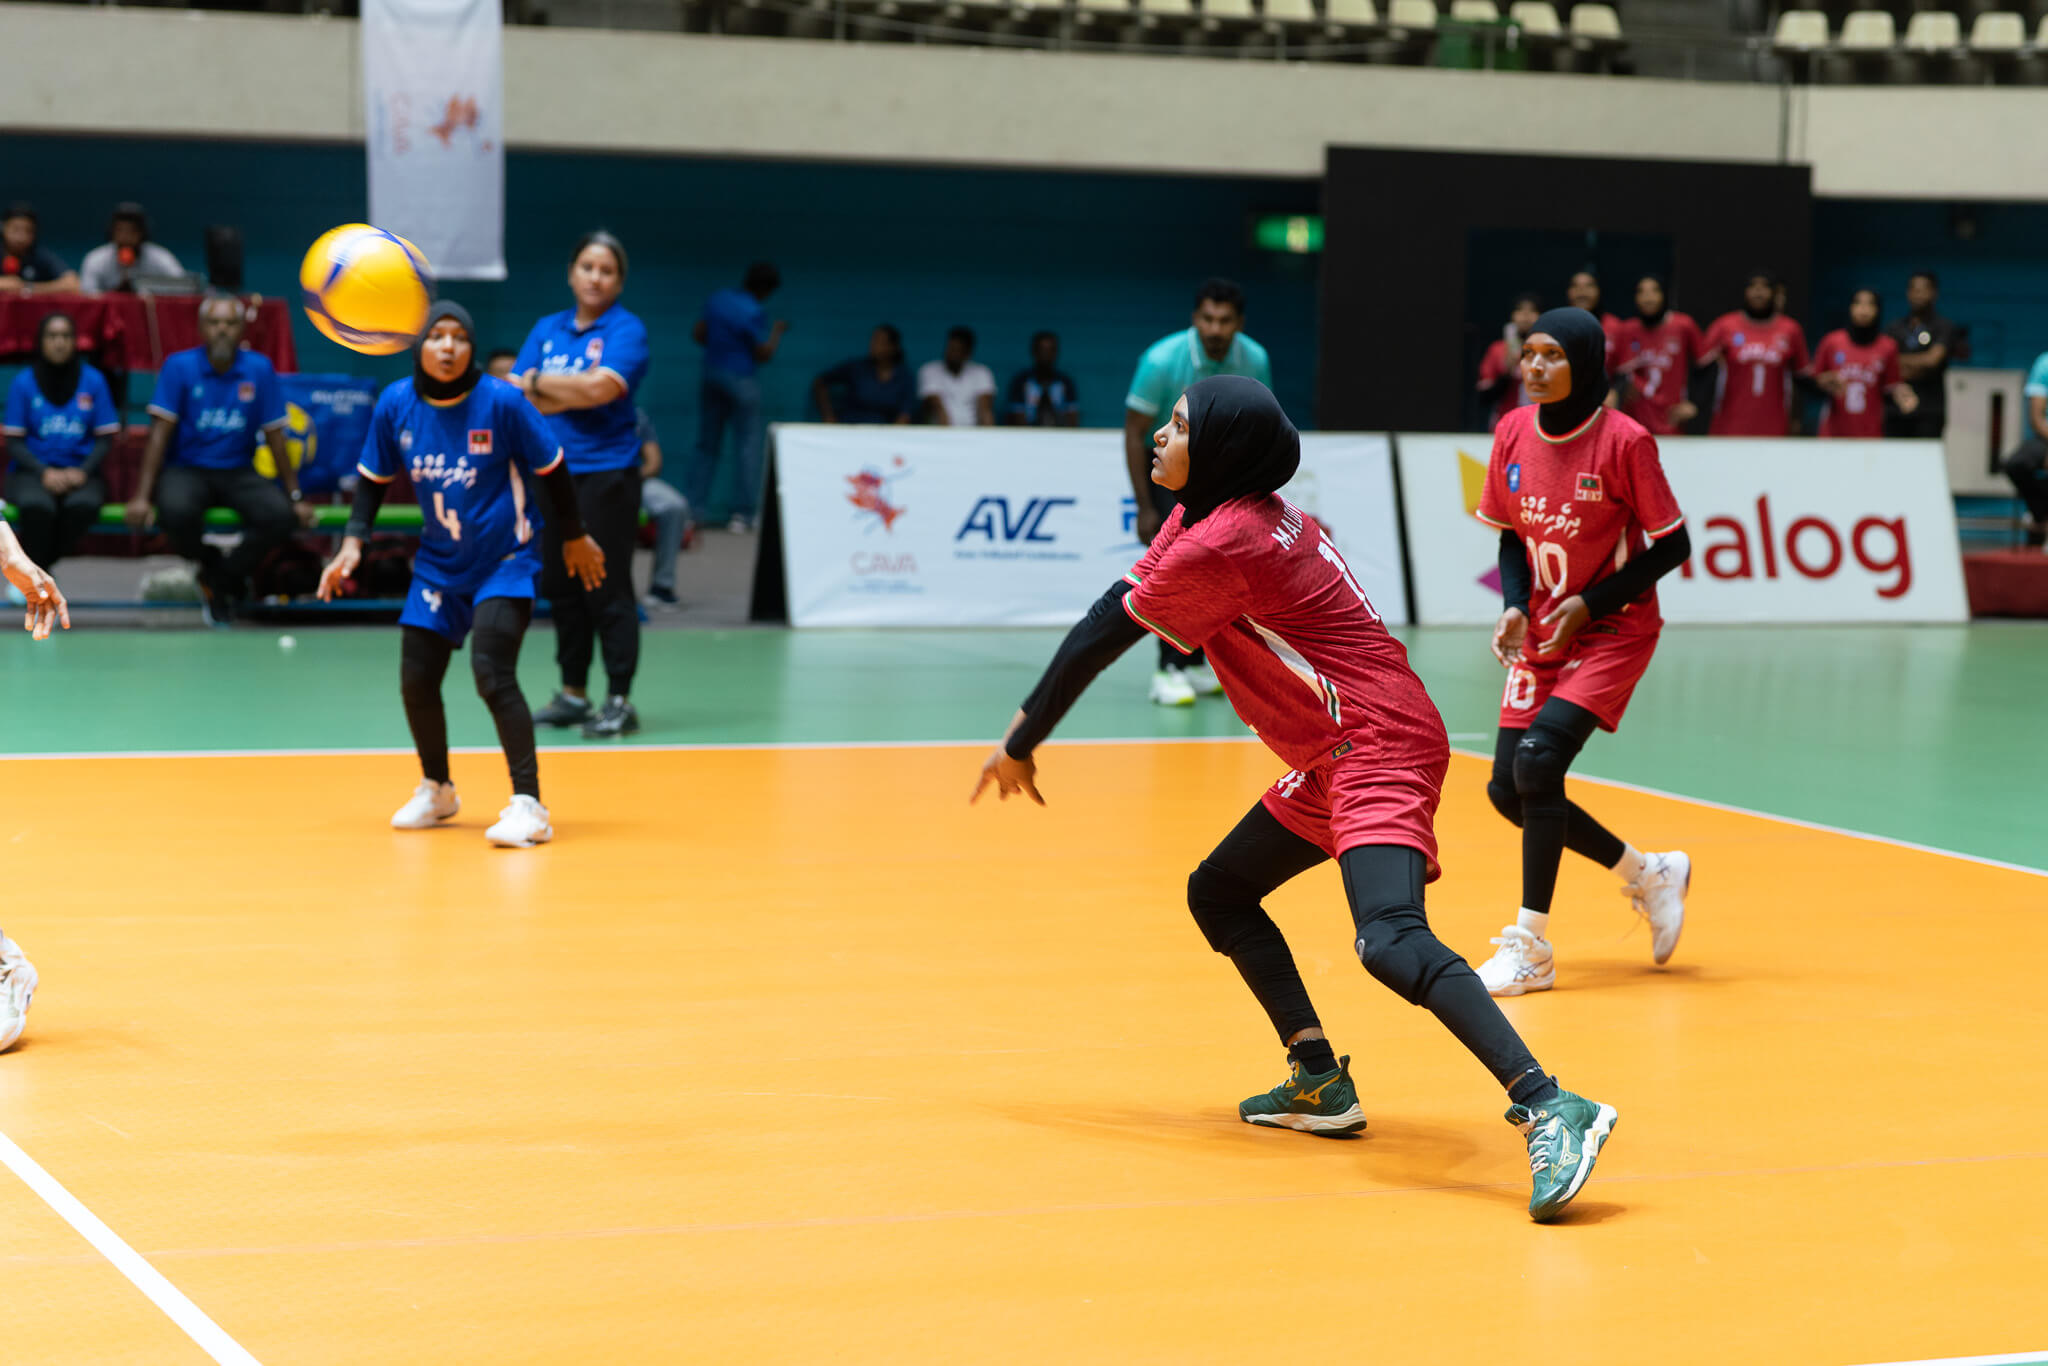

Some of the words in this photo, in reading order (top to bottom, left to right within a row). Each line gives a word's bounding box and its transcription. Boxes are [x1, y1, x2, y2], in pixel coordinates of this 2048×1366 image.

[433, 492, 461, 541] 4
[954, 497, 1077, 541] AVC
[1526, 536, 1567, 598] 10
[1680, 493, 1912, 599] alog
[1502, 665, 1537, 710] 10
